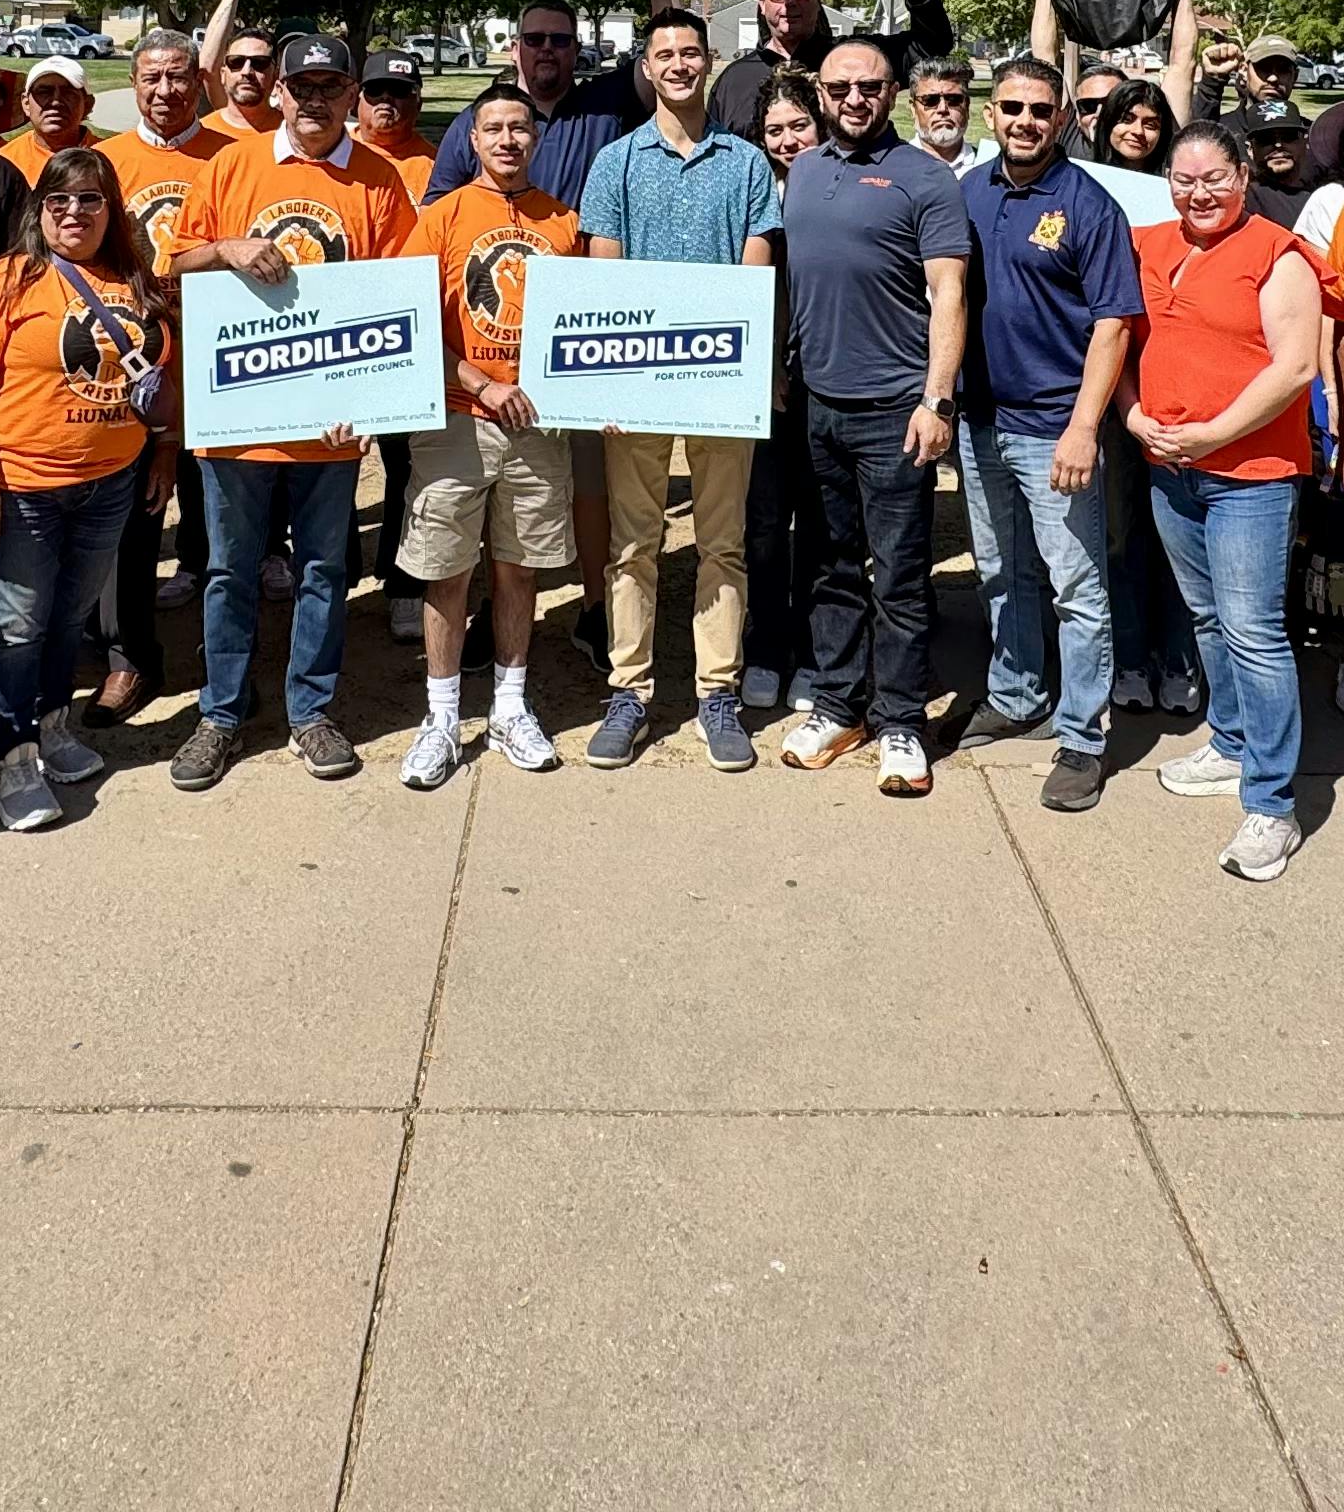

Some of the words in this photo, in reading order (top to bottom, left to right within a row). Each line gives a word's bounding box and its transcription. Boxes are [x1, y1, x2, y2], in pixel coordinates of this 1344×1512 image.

[141, 184, 192, 202] LABORE
[269, 202, 332, 223] LABORERS
[483, 230, 541, 246] LABORERS
[217, 309, 321, 342] ANTHONY
[554, 309, 656, 329] ANTHONY
[224, 324, 403, 377] TORDILLOS
[560, 333, 733, 366] TORDILLOS
[325, 370, 345, 382] FOR
[346, 366, 369, 378] CITY
[370, 359, 415, 373] COUNCIL
[655, 372, 674, 381] FOR
[676, 371, 699, 380] CITY
[700, 369, 744, 379] COUNCIL
